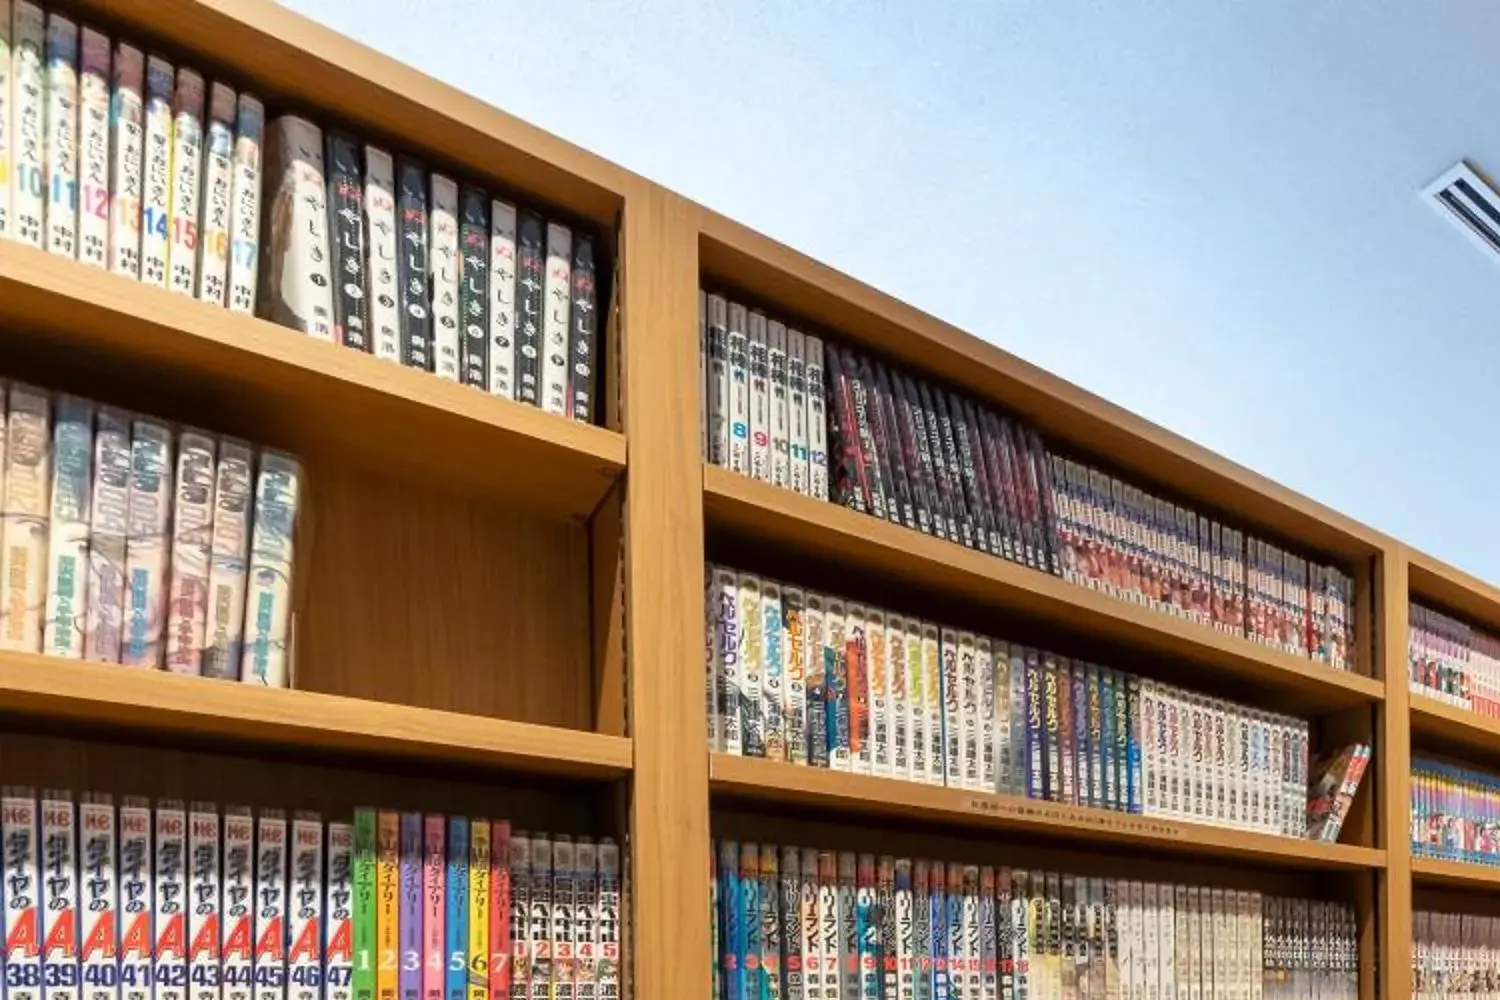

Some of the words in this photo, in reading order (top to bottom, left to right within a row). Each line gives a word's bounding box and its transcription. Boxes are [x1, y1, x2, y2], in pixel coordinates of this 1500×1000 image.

[16, 164, 42, 198] 10
[52, 174, 75, 211] 11
[84, 185, 107, 220] 12
[144, 206, 167, 240] 14
[172, 217, 198, 250] 15
[204, 229, 228, 261] 16
[233, 240, 257, 270] 17
[733, 422, 748, 439] 8
[754, 431, 768, 447] 9
[773, 437, 788, 452] 10
[791, 444, 807, 460] 11
[811, 449, 827, 465] 12
[514, 942, 526, 958] 1
[536, 942, 548, 958] 2
[558, 943, 571, 958] 3
[580, 943, 593, 958] 4
[603, 944, 617, 958] 5
[358, 951, 370, 971] 1
[380, 951, 395, 971] 2
[403, 951, 420, 971] 3
[427, 951, 442, 971] 4
[449, 951, 464, 971] 5
[472, 951, 486, 971] 6
[492, 953, 508, 971] 7
[808, 958, 819, 970] 6
[827, 958, 838, 970] 7
[864, 958, 876, 970] 9
[902, 957, 913, 970] 11
[8, 964, 40, 986] 38
[45, 964, 77, 986] 39
[85, 964, 116, 986] 40
[122, 964, 150, 986] 41
[156, 964, 187, 986] 42
[192, 965, 221, 987] 43
[224, 965, 253, 987] 44
[255, 965, 283, 987] 45
[292, 965, 320, 987] 46
[327, 965, 352, 987] 47
